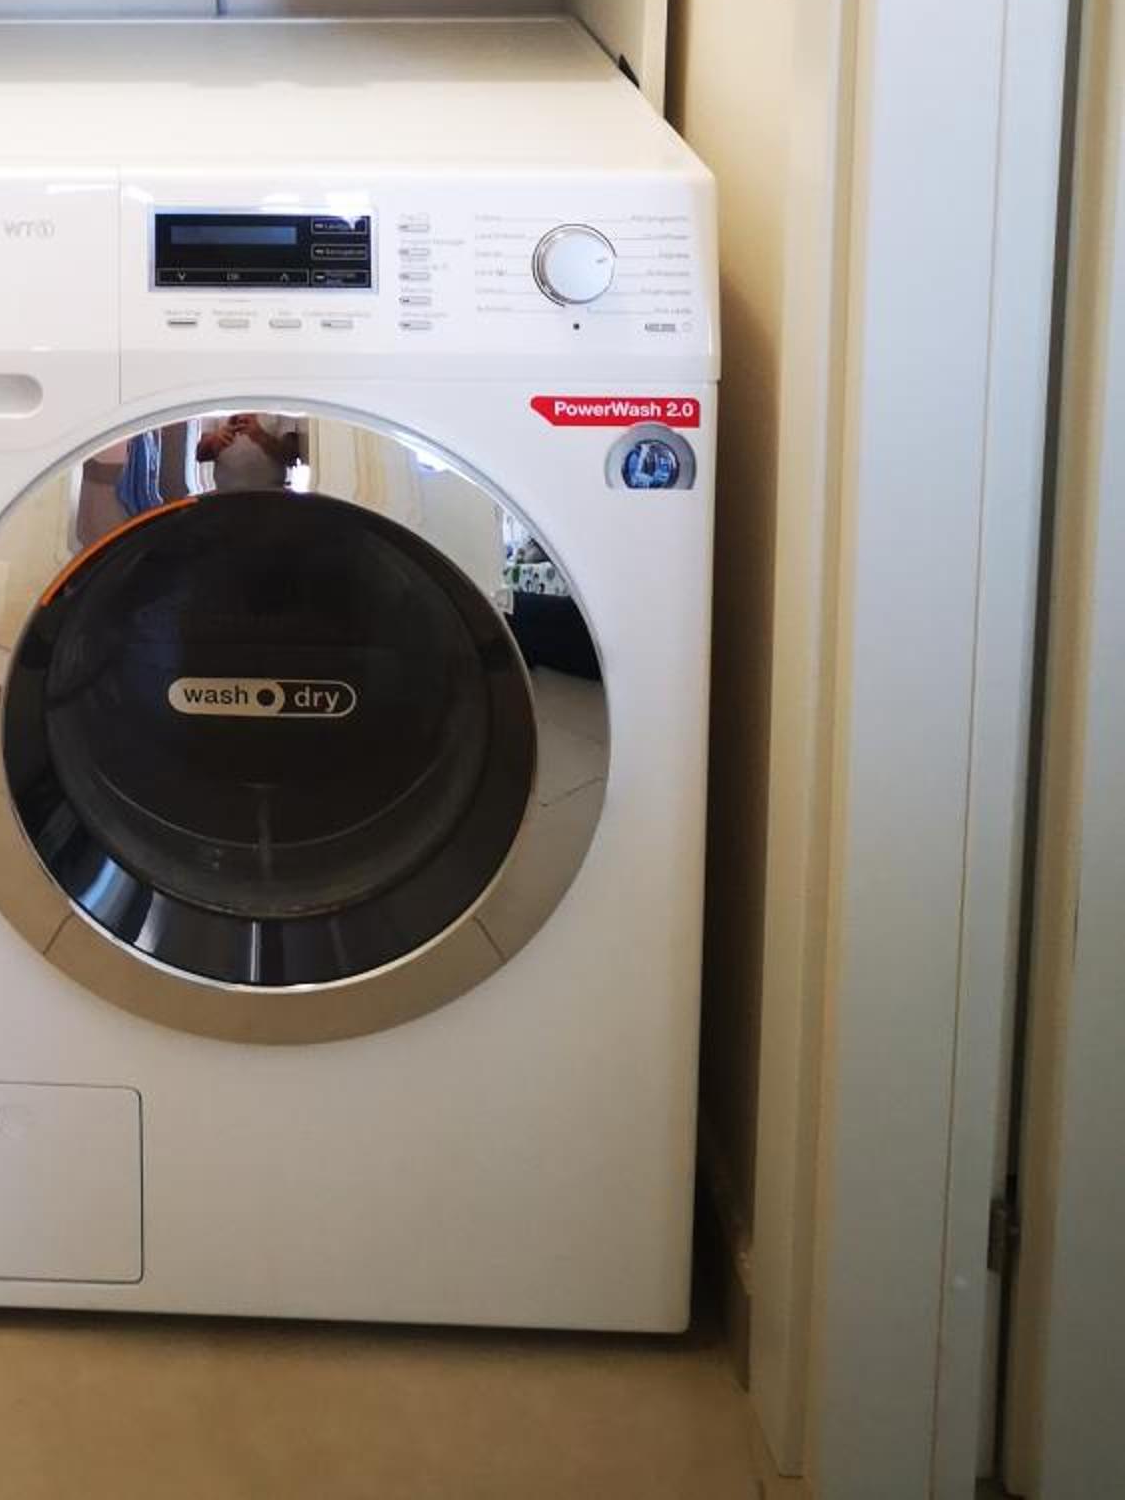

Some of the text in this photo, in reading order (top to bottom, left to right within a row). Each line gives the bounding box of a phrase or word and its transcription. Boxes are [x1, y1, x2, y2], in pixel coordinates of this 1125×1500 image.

[554, 401, 694, 418] PowerWash 2.0
[183, 685, 340, 713] wash dry
